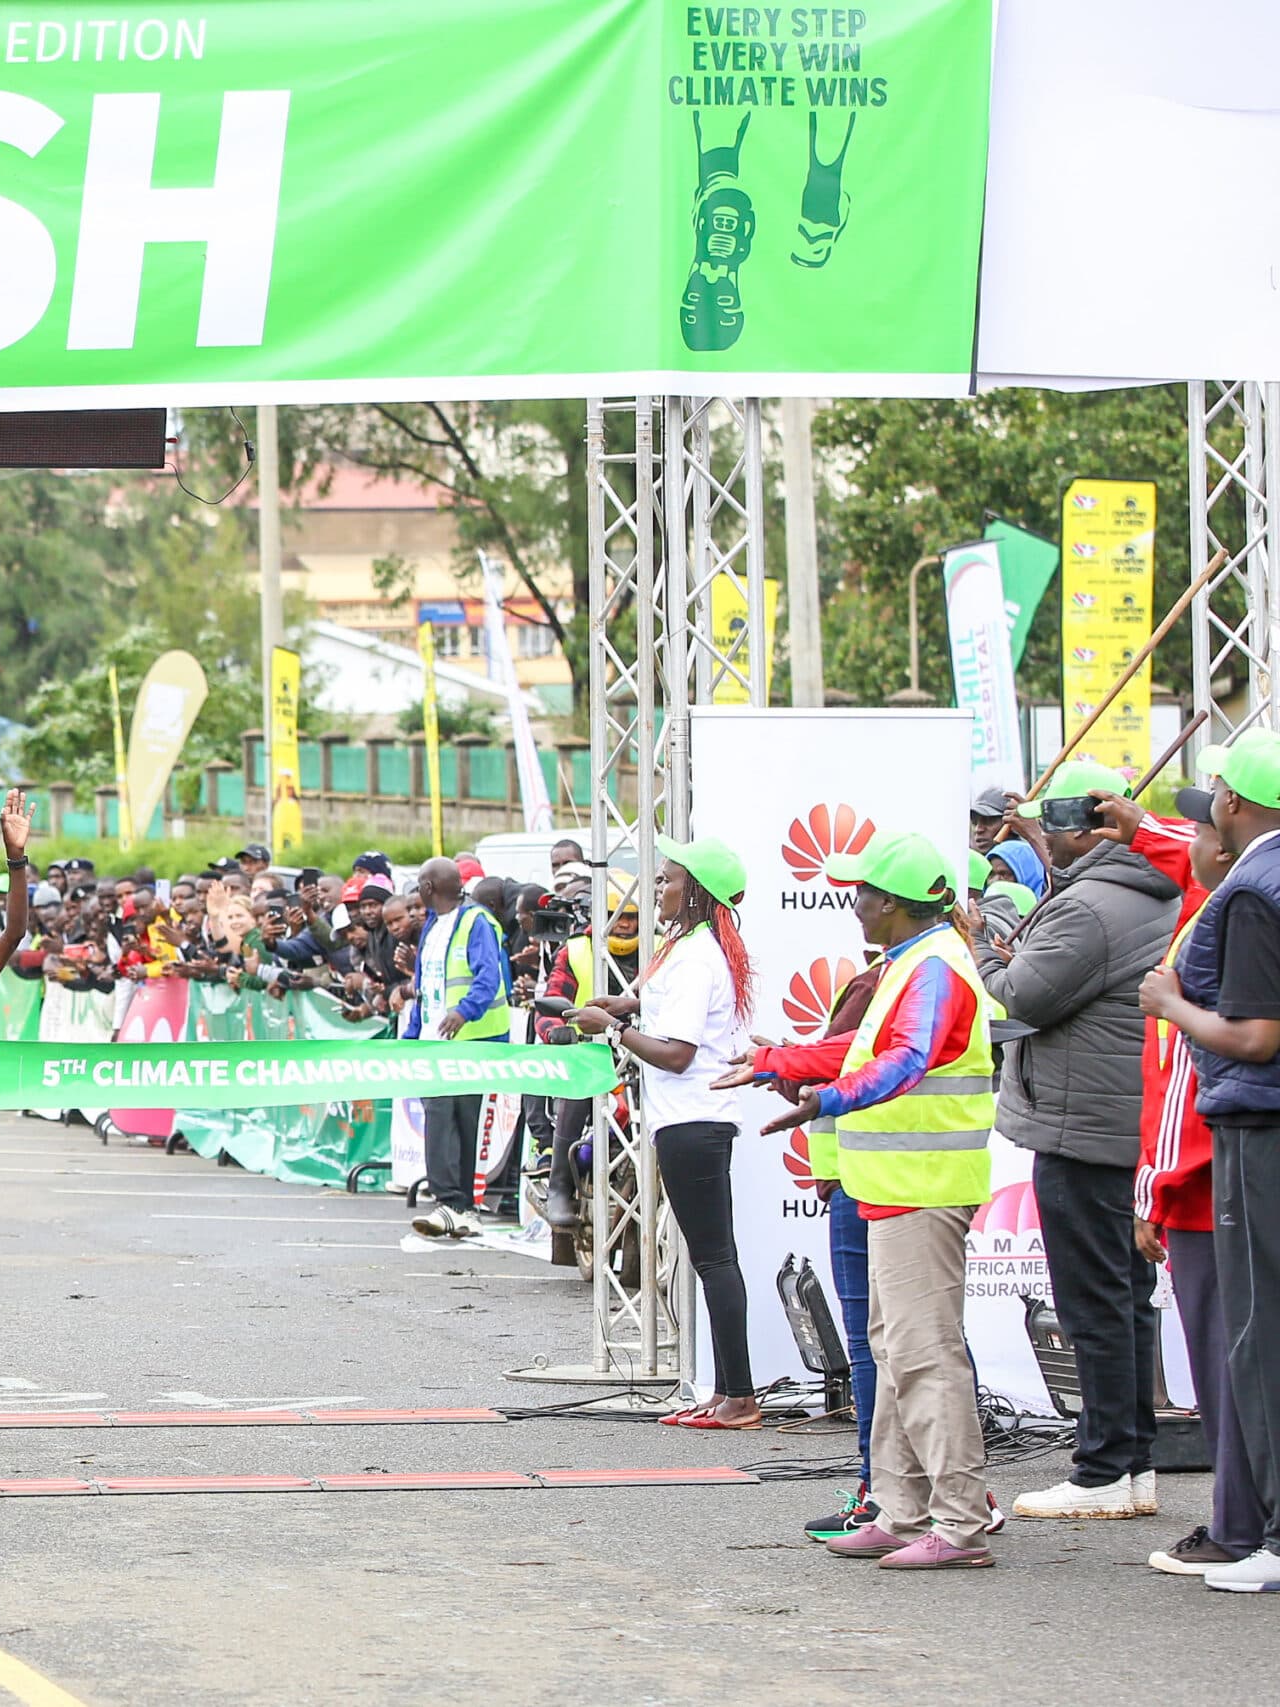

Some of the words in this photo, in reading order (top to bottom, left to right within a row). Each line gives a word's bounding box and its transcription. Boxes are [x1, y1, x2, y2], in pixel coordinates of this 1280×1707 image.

[687, 7, 781, 37] EVERY
[791, 8, 867, 38] STEP
[5, 18, 208, 64] EDITION
[693, 42, 788, 71] EVERY
[798, 43, 861, 72] WIN
[668, 76, 795, 106] CLIMATE
[805, 77, 888, 107] WINS
[41, 1059, 87, 1086] 5TH
[92, 1059, 228, 1086] CLIMATE
[235, 1058, 432, 1086] CHAMPIONS
[439, 1059, 570, 1081] EDITION
[964, 1261, 1016, 1275] FRICA
